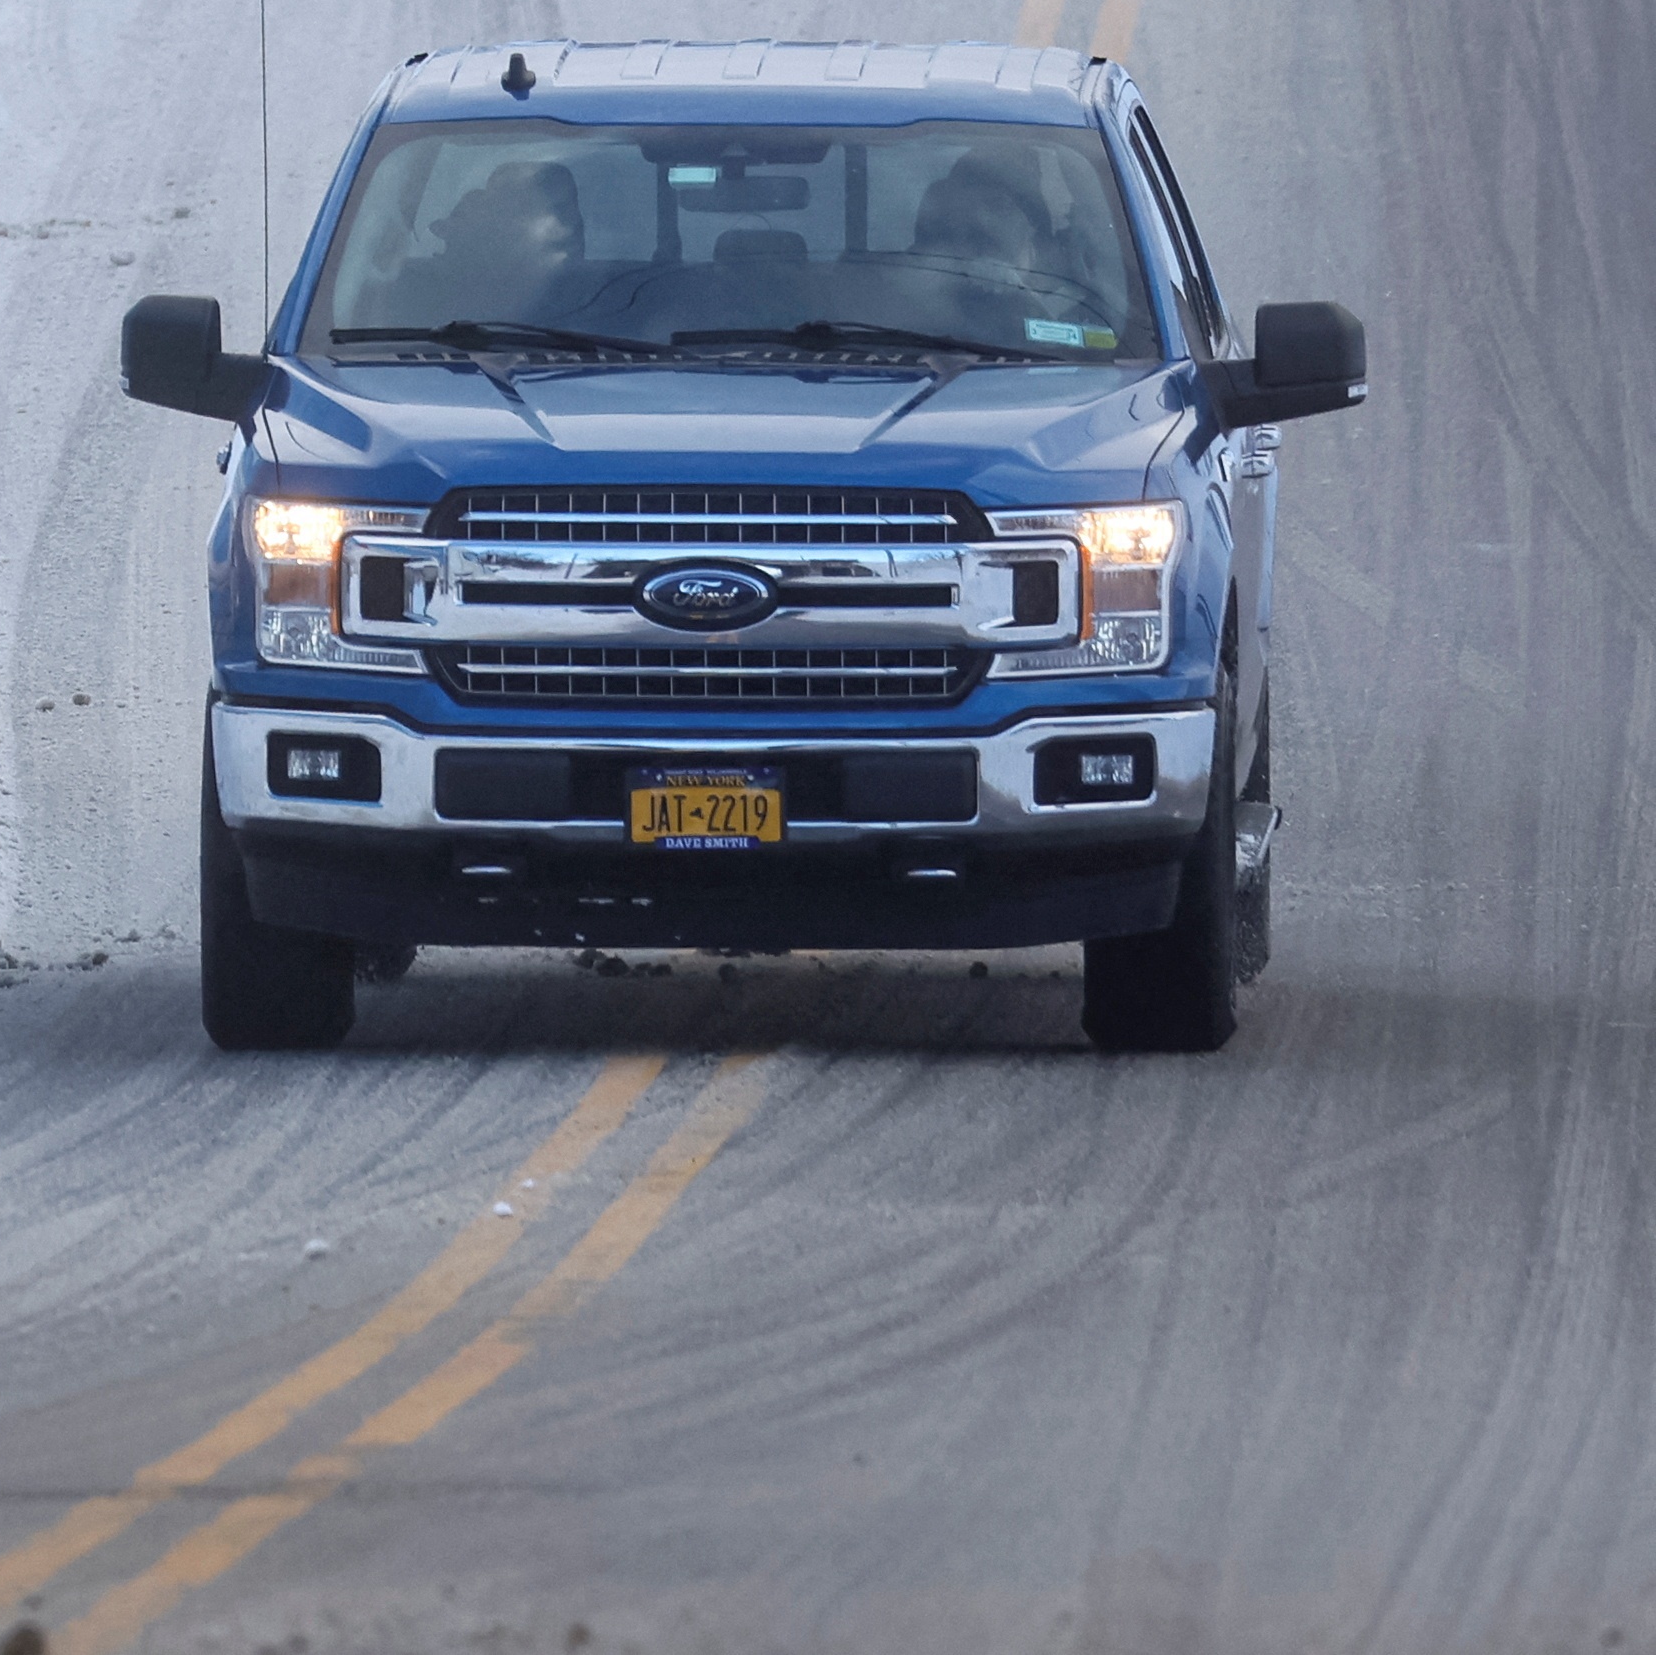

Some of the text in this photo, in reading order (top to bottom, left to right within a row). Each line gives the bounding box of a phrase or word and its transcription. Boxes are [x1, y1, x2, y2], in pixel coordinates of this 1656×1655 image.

[673, 579, 739, 607] Ford
[666, 774, 746, 786] NEW YORK
[642, 794, 768, 832] JAT 2219
[665, 837, 749, 849] DAVE SMITH
